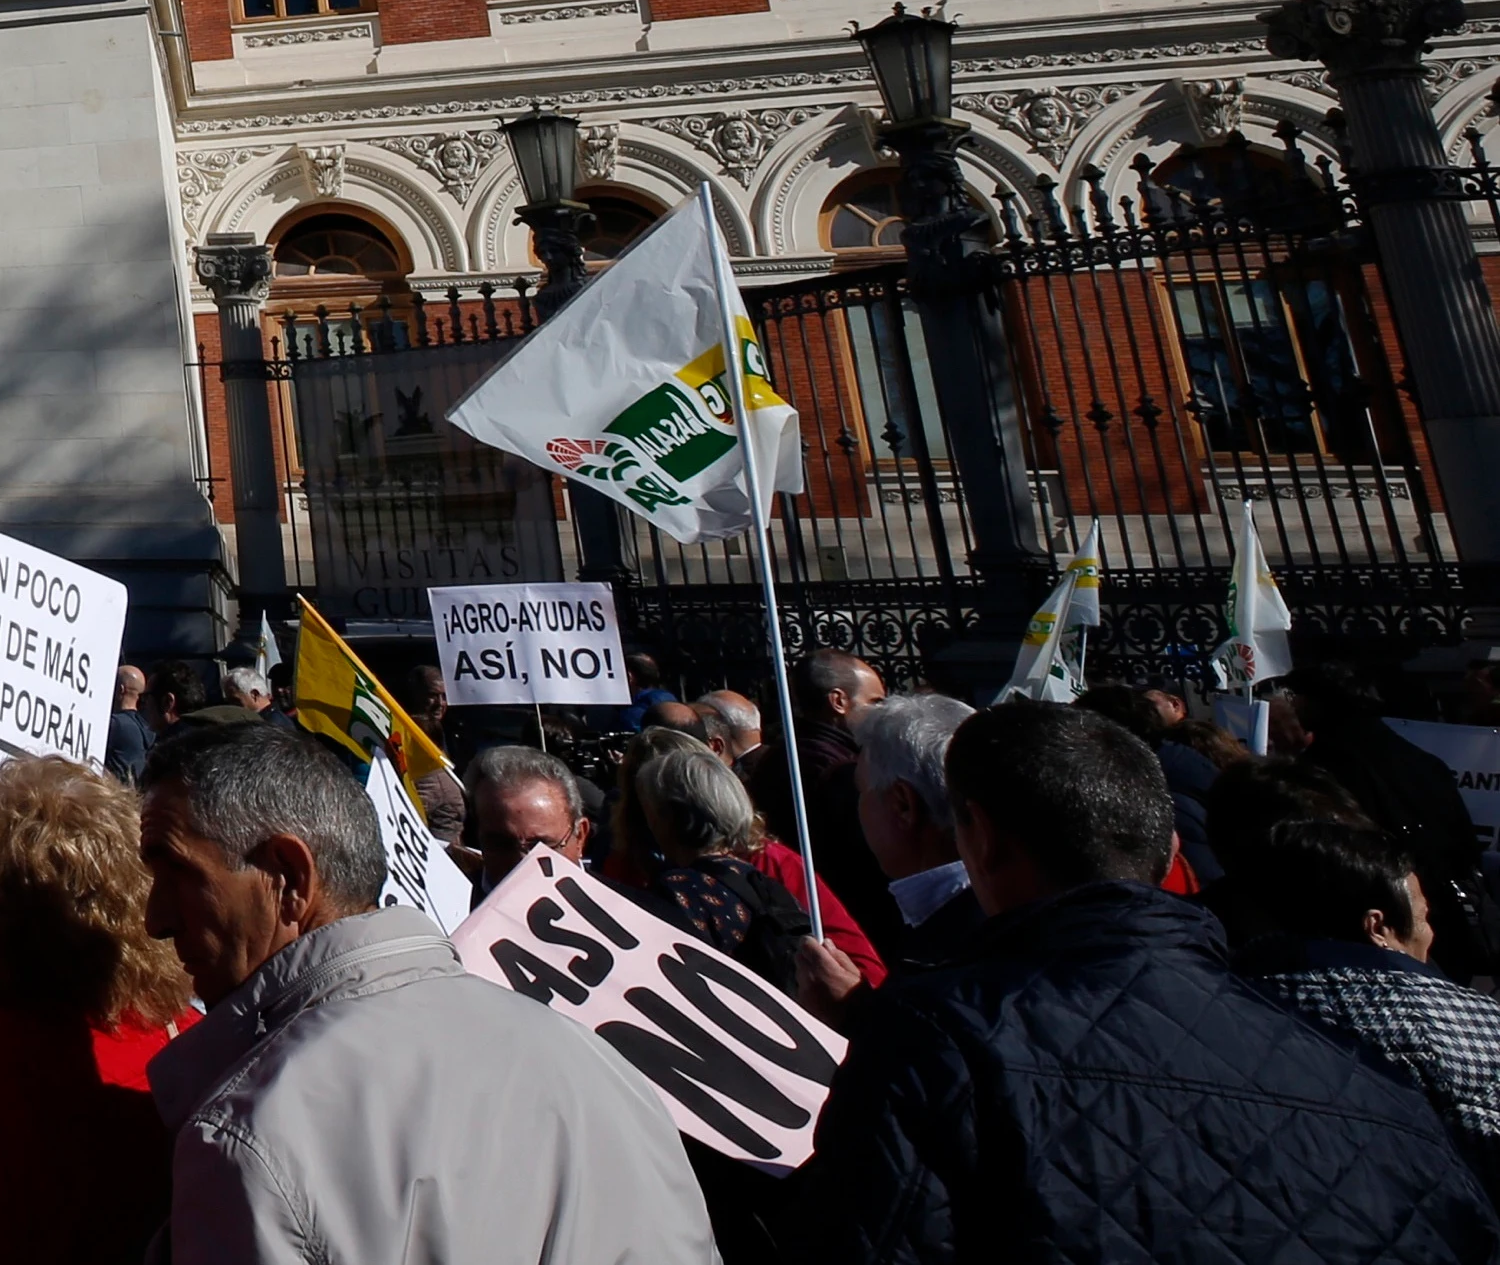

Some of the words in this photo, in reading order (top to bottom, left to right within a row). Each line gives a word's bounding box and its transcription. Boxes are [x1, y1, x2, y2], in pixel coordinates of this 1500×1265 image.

[15, 561, 81, 623] POCO
[349, 545, 520, 580] VISITAS
[443, 600, 607, 643] ¡AGRO-AYUDAS
[6, 620, 38, 670] DE
[43, 637, 93, 698] MÁS.
[454, 641, 530, 685] ASÍ,
[541, 648, 615, 679] NO!
[490, 856, 640, 1006] ASÍ
[595, 942, 840, 1160] NO
